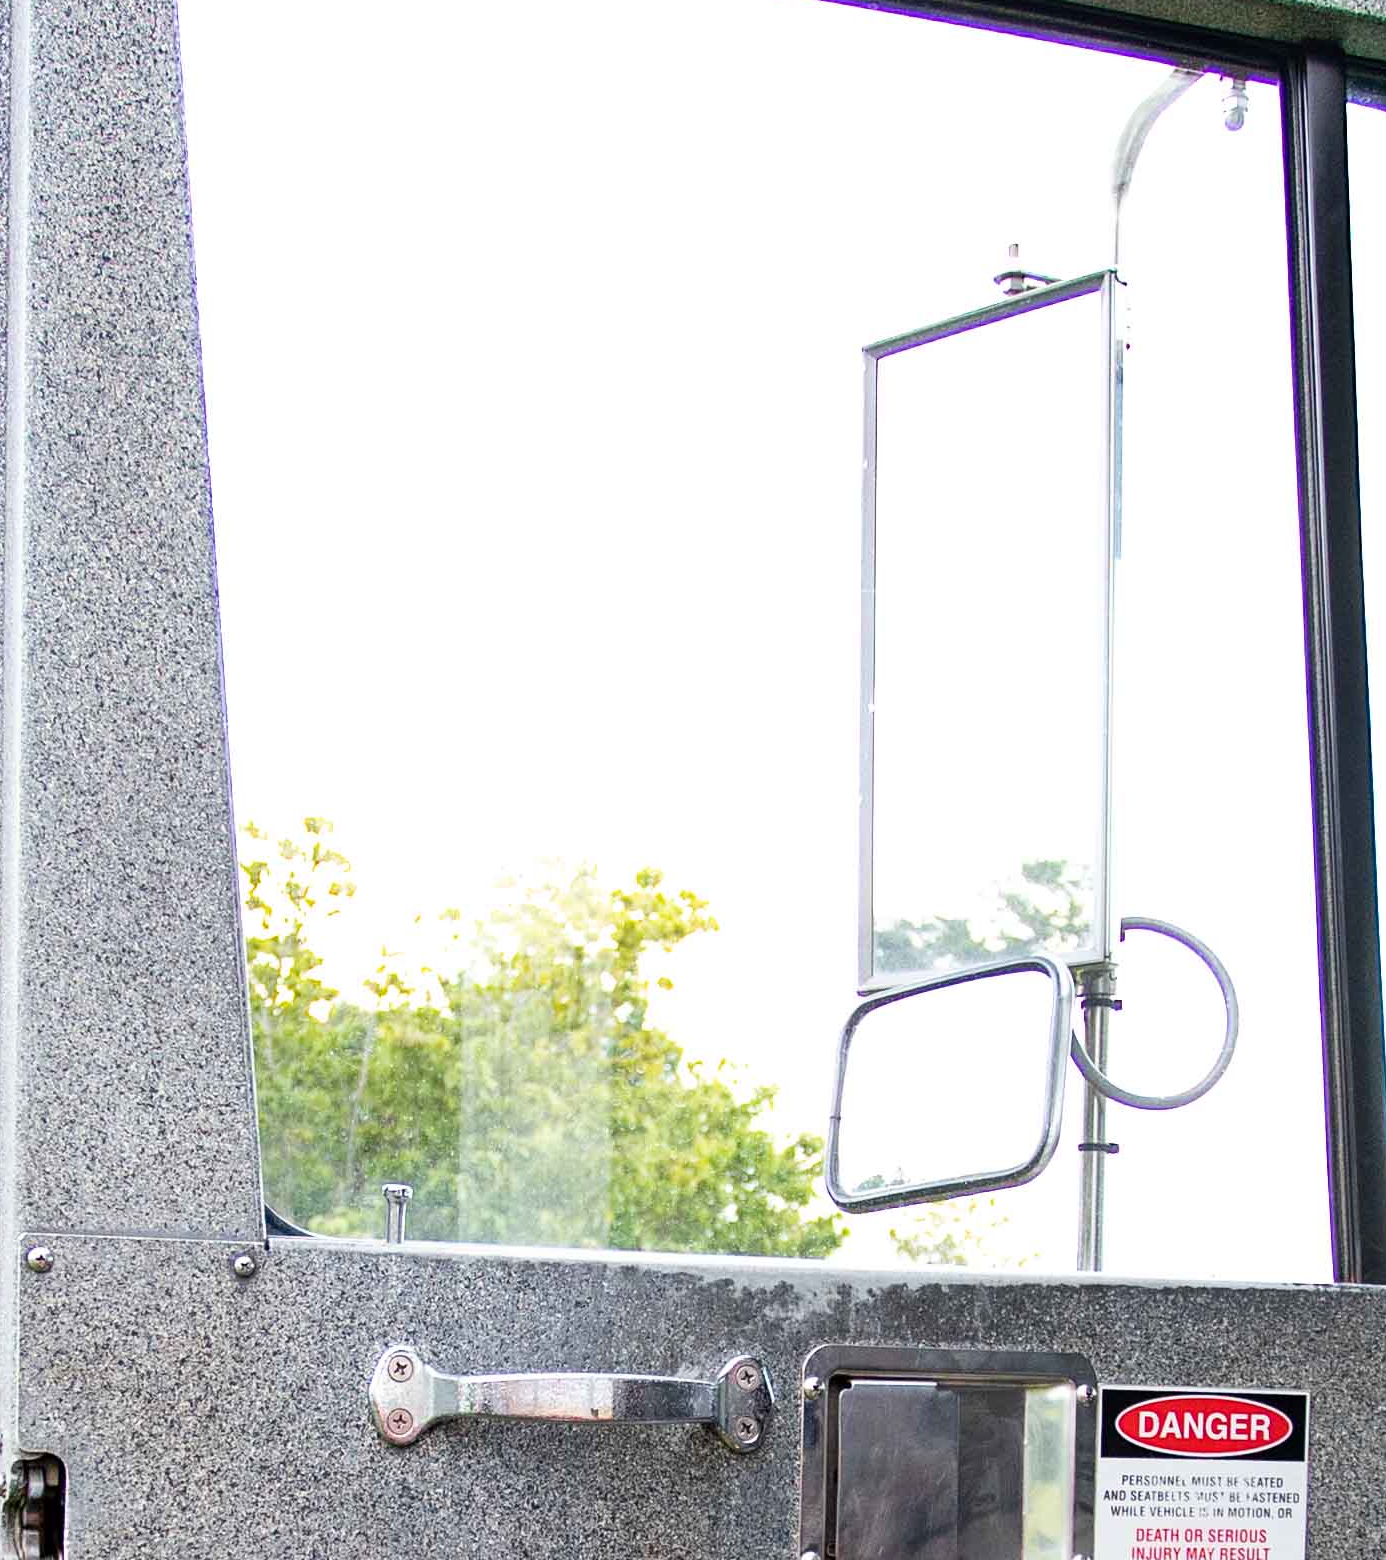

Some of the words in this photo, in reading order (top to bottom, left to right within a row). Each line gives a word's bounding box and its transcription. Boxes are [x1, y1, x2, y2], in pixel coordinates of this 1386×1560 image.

[1138, 1411, 1270, 1441] DANGER
[1121, 1474, 1186, 1488] PERSONNEL
[1192, 1476, 1222, 1488] MUST
[1244, 1477, 1284, 1488] SEATED
[1103, 1490, 1128, 1501] AND
[1130, 1490, 1190, 1502] SEATBELTS
[1229, 1492, 1241, 1503] BE
[1110, 1506, 1145, 1518] WHILE
[1150, 1506, 1195, 1518] VEHICLE
[1213, 1508, 1224, 1518] IN
[1228, 1508, 1274, 1520] MOTION,
[1278, 1508, 1293, 1519] OR
[1136, 1528, 1180, 1543] DEATH
[1184, 1529, 1203, 1543] OR
[1208, 1529, 1267, 1544] SERIOUS
[1131, 1547, 1180, 1560] INJURY
[1186, 1547, 1214, 1560] MAY
